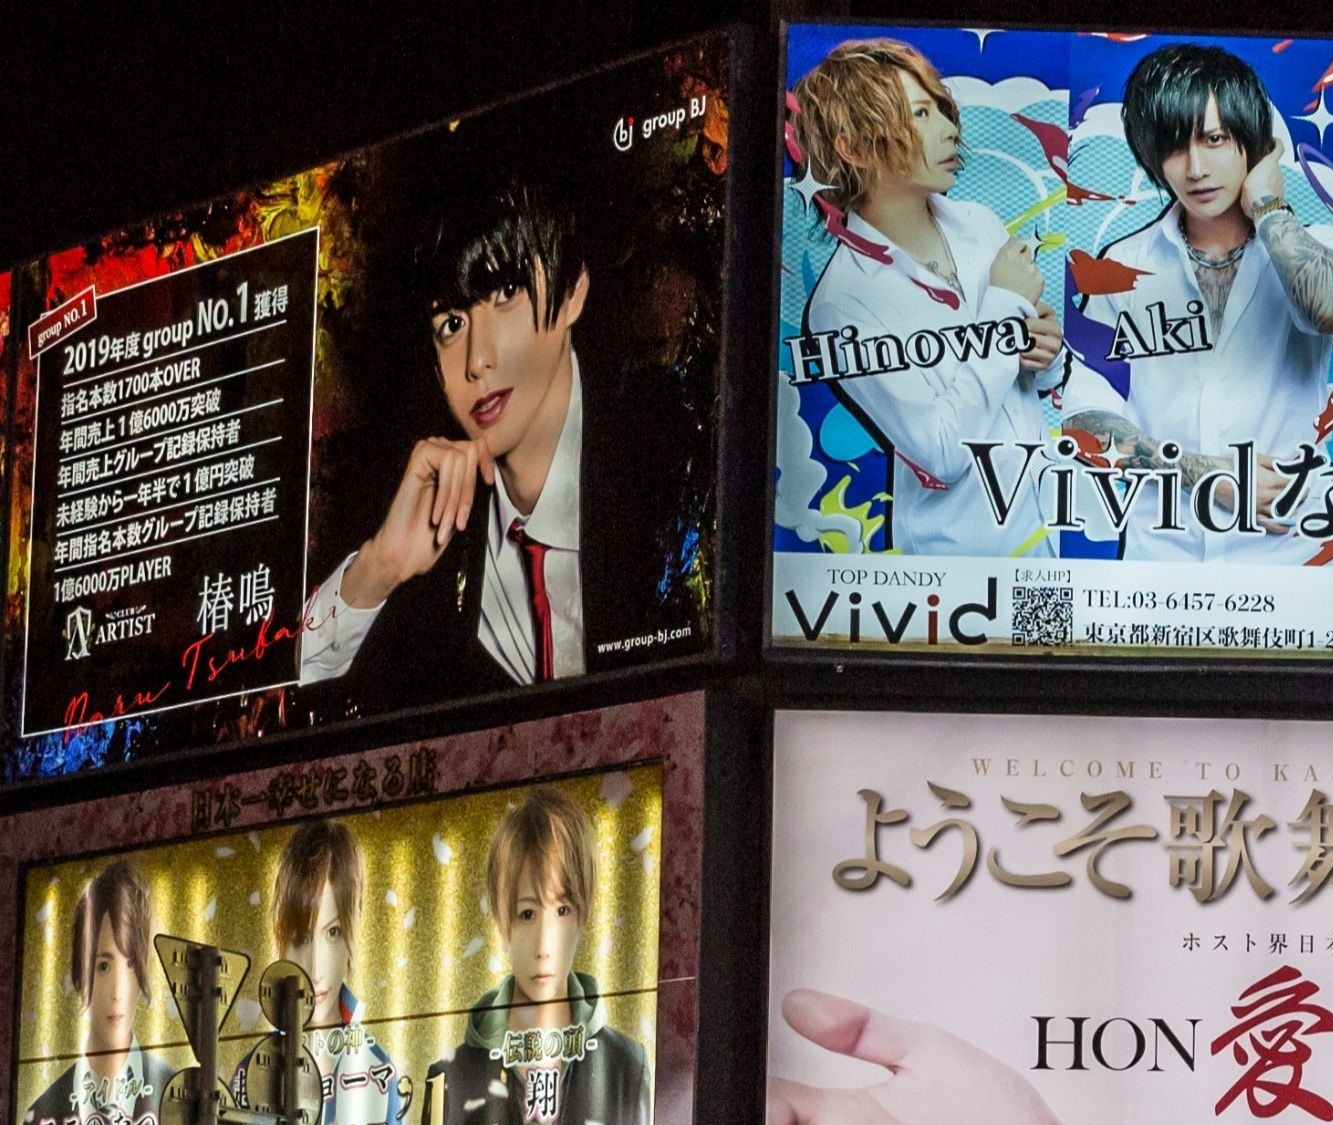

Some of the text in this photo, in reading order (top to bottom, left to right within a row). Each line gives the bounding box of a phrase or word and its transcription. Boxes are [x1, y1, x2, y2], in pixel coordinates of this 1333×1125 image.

[643, 107, 686, 139] group
[690, 94, 707, 119] BJ
[37, 323, 62, 347] group
[62, 331, 141, 377] 2019年度
[143, 319, 194, 358] group
[254, 285, 289, 321] 獲得
[784, 315, 1036, 386] Hinowa
[1105, 300, 1213, 362] Aki
[60, 357, 201, 418] 指名本数1700本OVER
[57, 419, 242, 490] 年間売上グループ記録保持者
[54, 487, 277, 565] 年間指名本数グループ記録保持者
[53, 555, 172, 604] 1億6000万PLAYER
[827, 568, 947, 587] TOP DANDY
[1082, 588, 1276, 614] TEL:03-6457-6228
[95, 613, 156, 645] ARTIST
[597, 621, 692, 656] www.group-bj.com
[971, 757, 1163, 780] WELCOME
[1197, 760, 1242, 782] TO
[1030, 1014, 1203, 1073] HON
[527, 1072, 558, 1117] 翔
